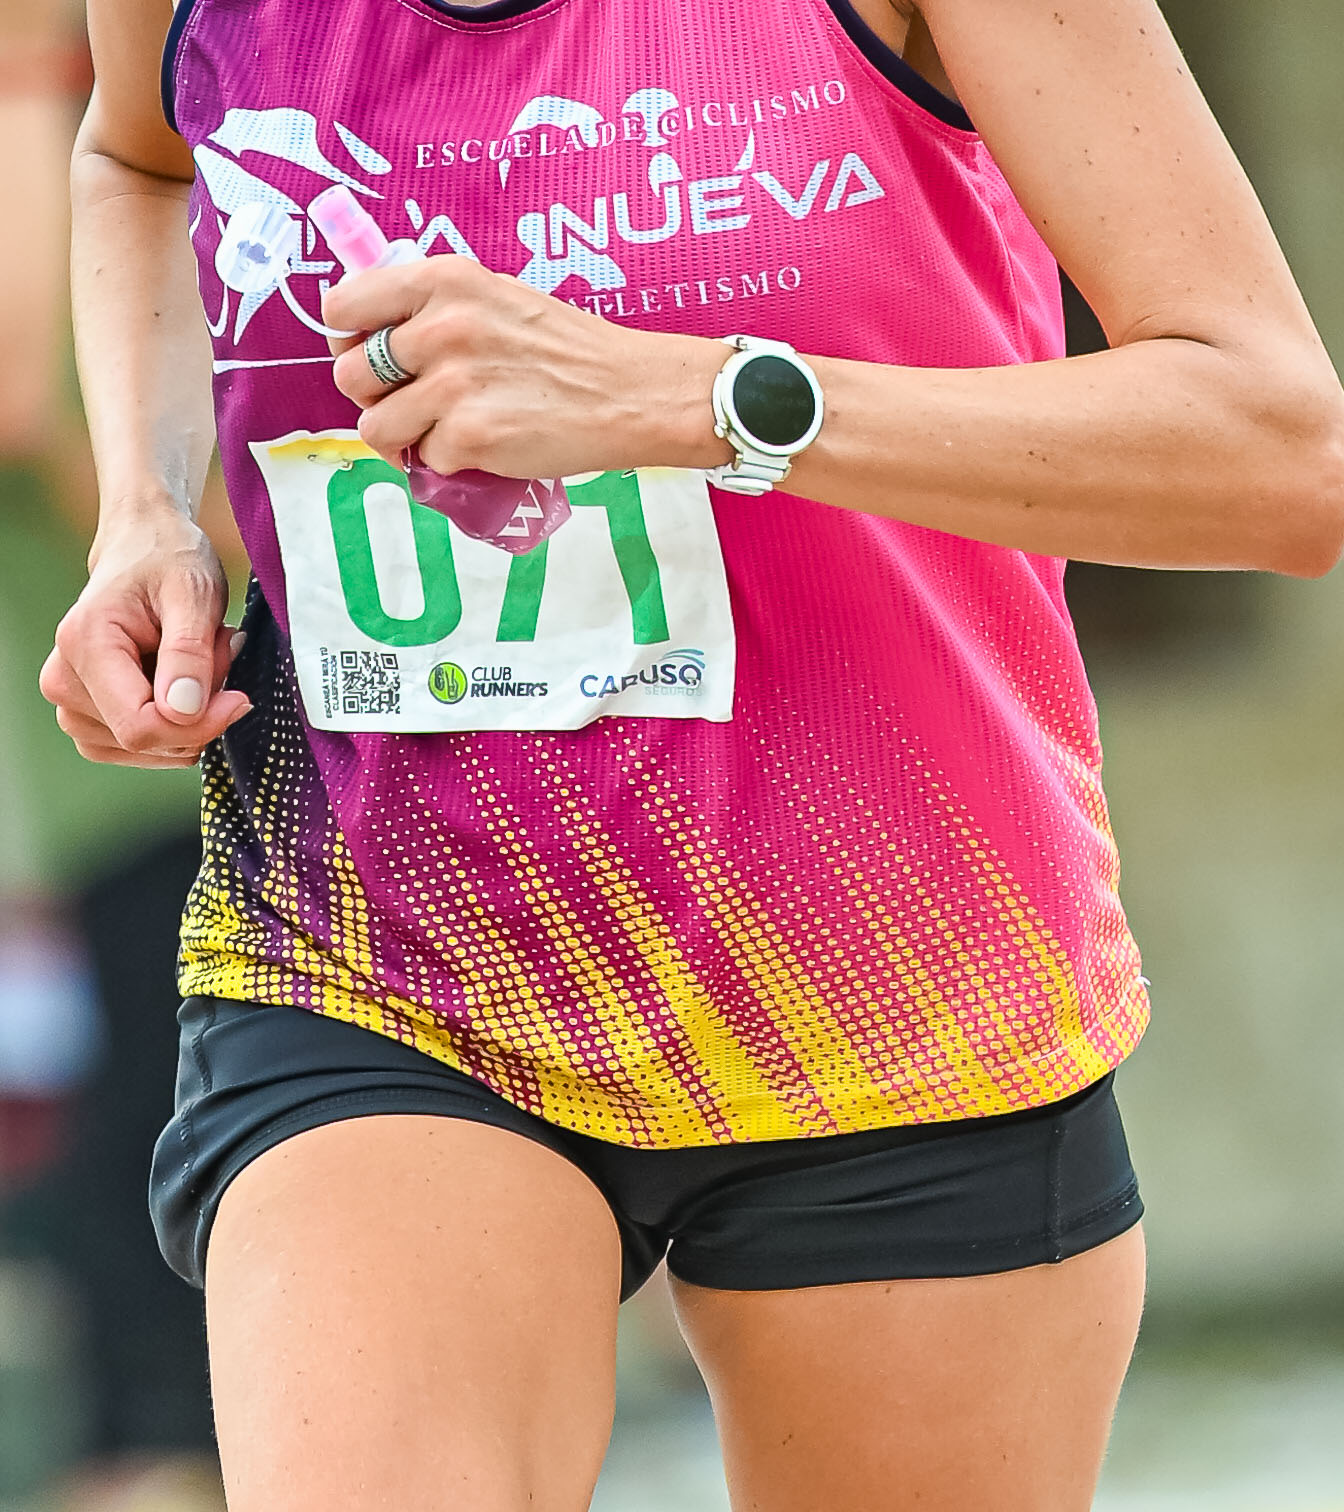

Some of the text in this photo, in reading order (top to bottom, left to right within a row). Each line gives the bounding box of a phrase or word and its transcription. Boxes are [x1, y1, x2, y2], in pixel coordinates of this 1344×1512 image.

[415, 80, 846, 170] ESCUELA DE CICLISMO
[549, 152, 886, 257] NUEVA
[471, 666, 512, 681] CLUB
[579, 663, 702, 698] CARUSO
[645, 686, 703, 697] SEGUROS
